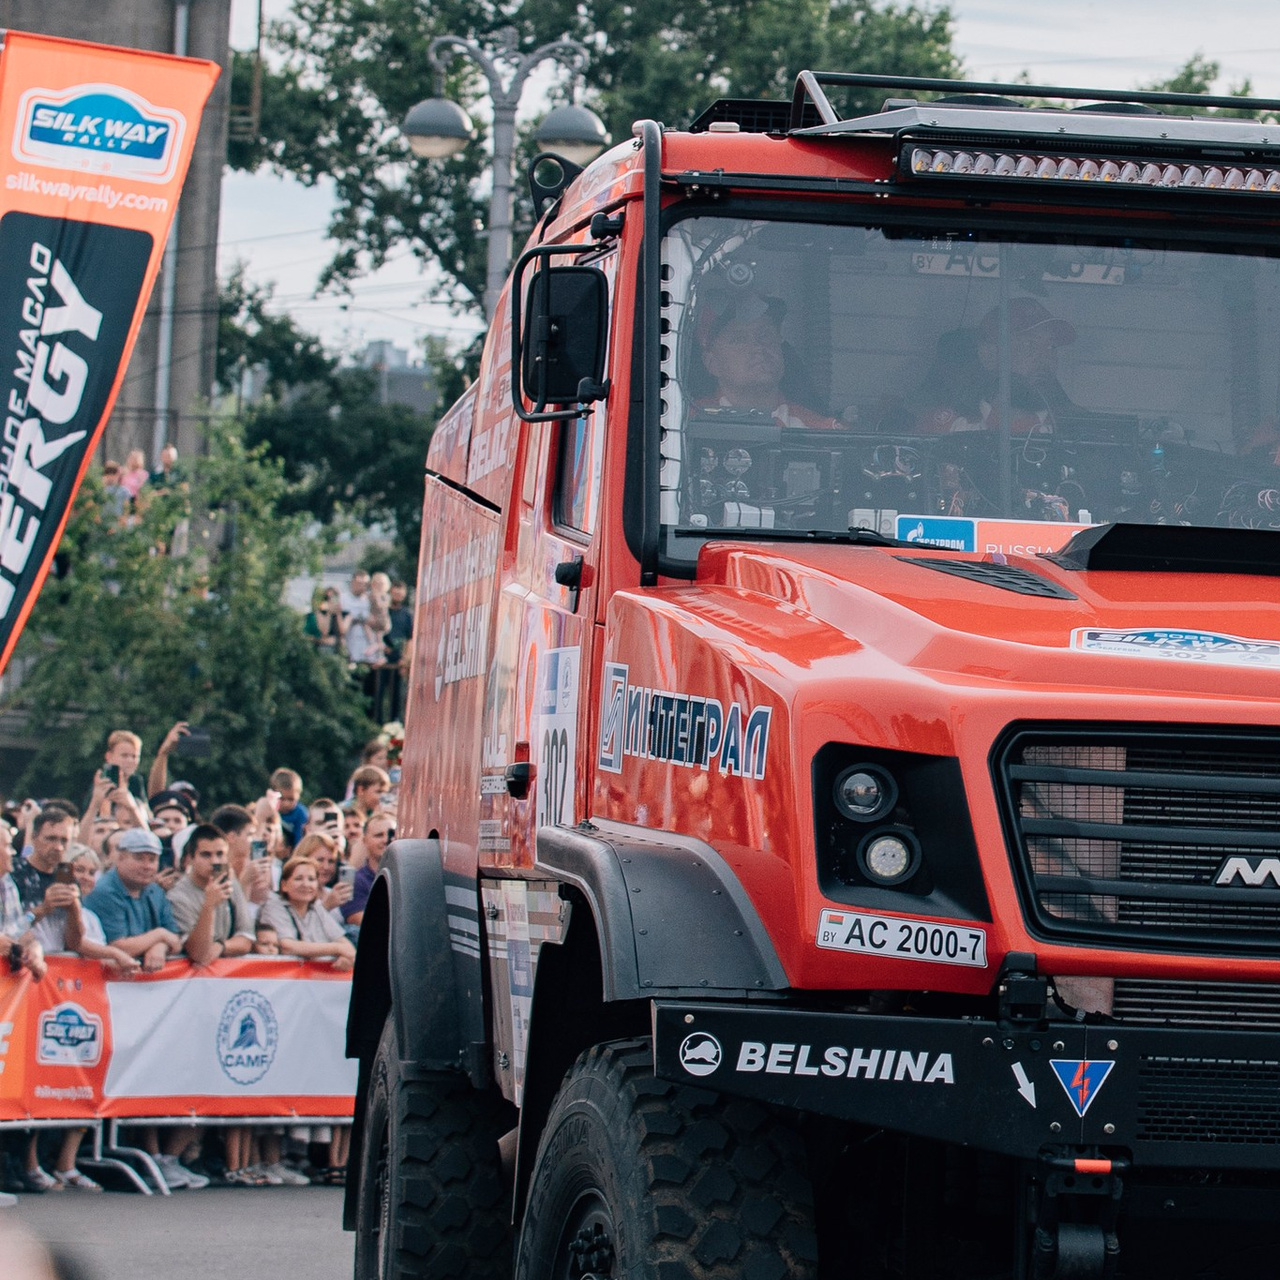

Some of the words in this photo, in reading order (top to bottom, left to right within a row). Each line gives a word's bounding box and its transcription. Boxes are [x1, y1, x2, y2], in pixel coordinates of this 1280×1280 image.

[33, 108, 104, 135] SILK
[104, 119, 168, 145] WAY
[63, 132, 131, 150] RALLY
[6, 171, 168, 212] silkwayrally.com
[1096, 632, 1187, 648] SILK
[1191, 640, 1274, 653] WAY
[1158, 650, 1208, 661] 302
[623, 685, 774, 781] ИНТЕГРАЛ
[823, 929, 838, 944] BY
[844, 918, 887, 950] AC
[899, 924, 982, 962] 2000-7
[224, 1054, 268, 1068] CAMF
[735, 1041, 956, 1085] BELSHINA
